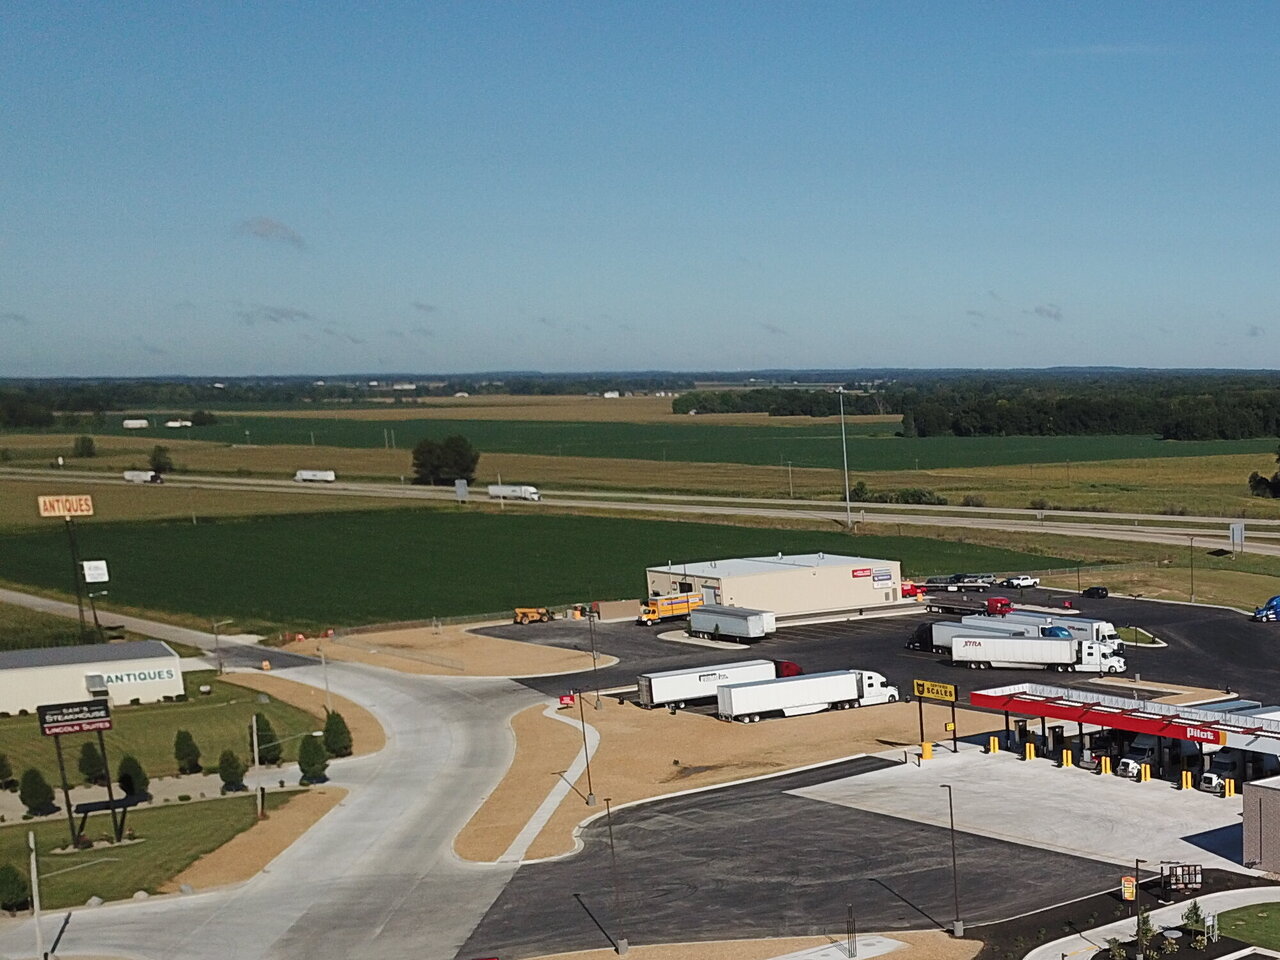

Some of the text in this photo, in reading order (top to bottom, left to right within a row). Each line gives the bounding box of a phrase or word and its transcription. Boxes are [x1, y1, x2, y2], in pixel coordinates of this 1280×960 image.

[43, 499, 91, 513] ANTIQUES
[106, 669, 174, 684] ANTIQUES
[927, 687, 953, 698] SCALES
[62, 706, 89, 714] SAM'S
[45, 710, 106, 722] STEAKHOUSE
[45, 725, 80, 735] LINCOLN
